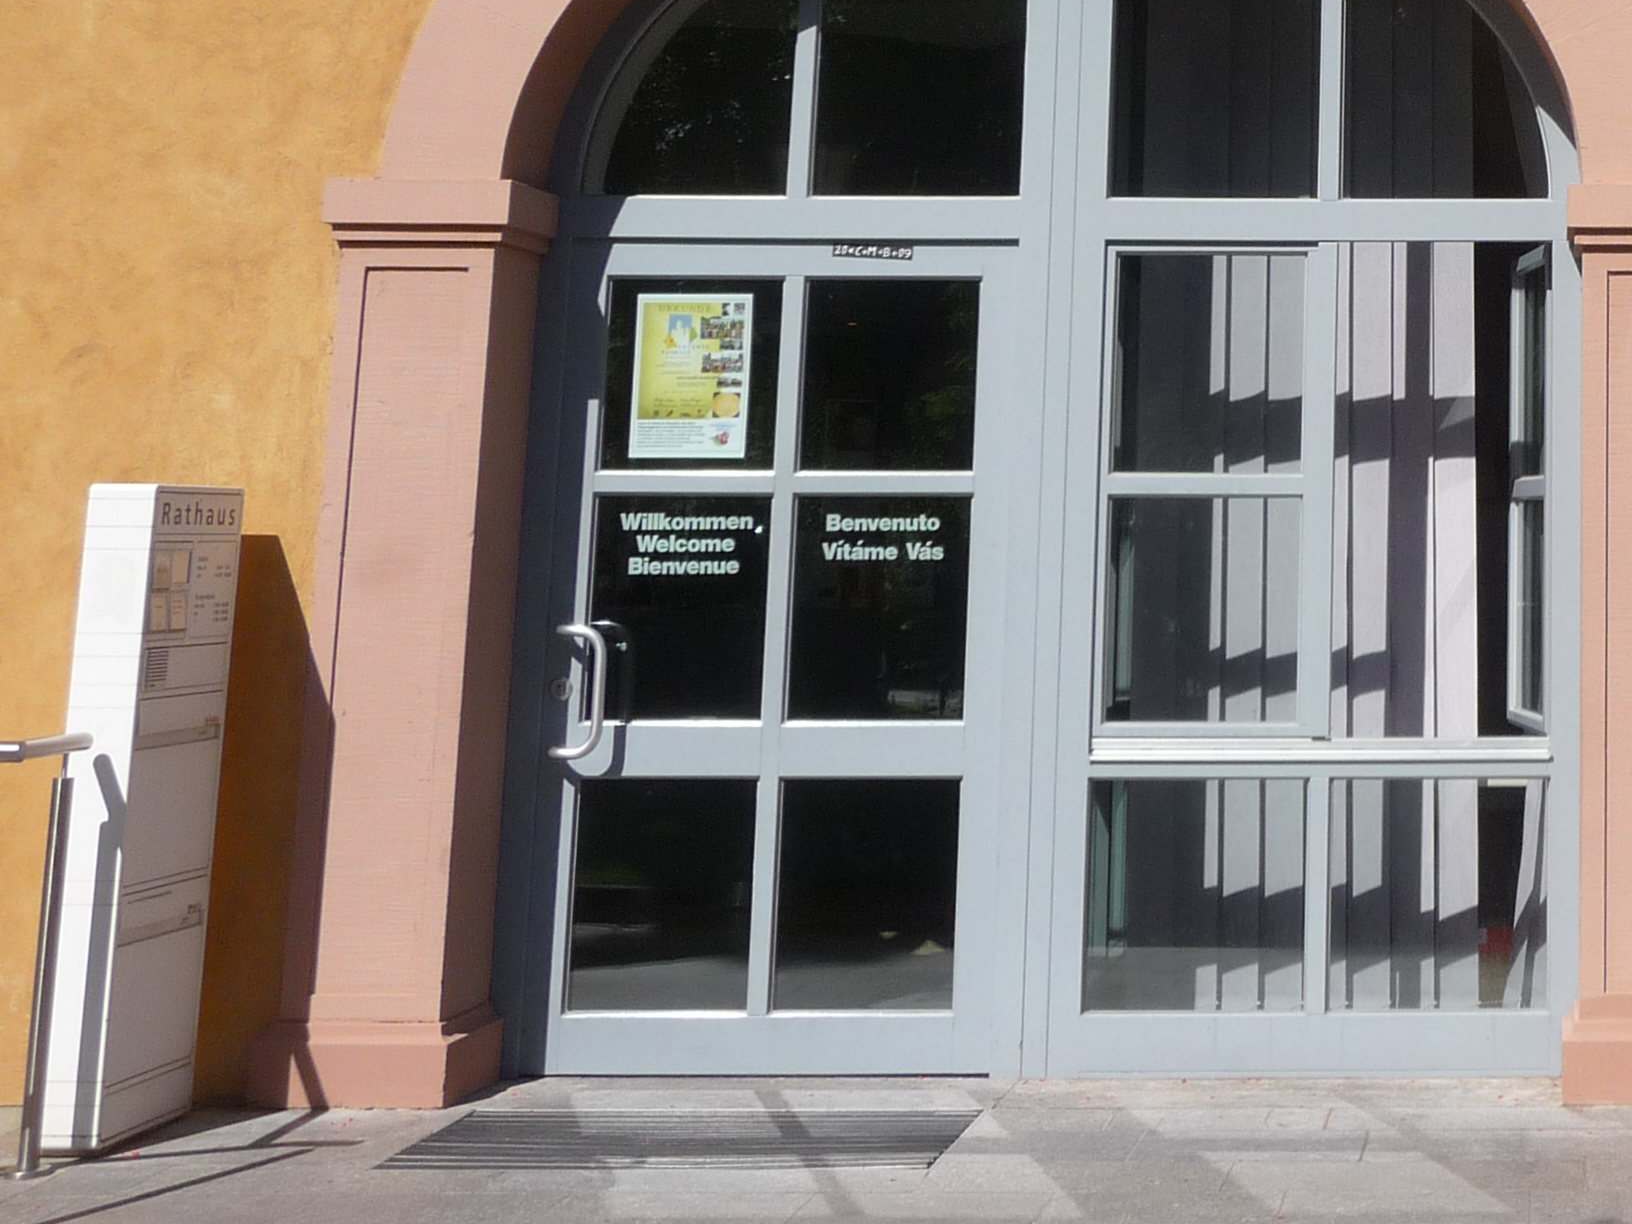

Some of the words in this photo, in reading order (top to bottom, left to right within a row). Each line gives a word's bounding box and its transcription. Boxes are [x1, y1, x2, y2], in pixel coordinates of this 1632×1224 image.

[161, 500, 236, 526] Rathaus
[620, 513, 754, 531] Willkommen
[825, 514, 941, 532] Benvenuto
[636, 535, 735, 553] Welcome
[822, 541, 898, 561] Vítáme
[906, 541, 944, 561] Vás
[628, 557, 740, 576] Bienvenue
